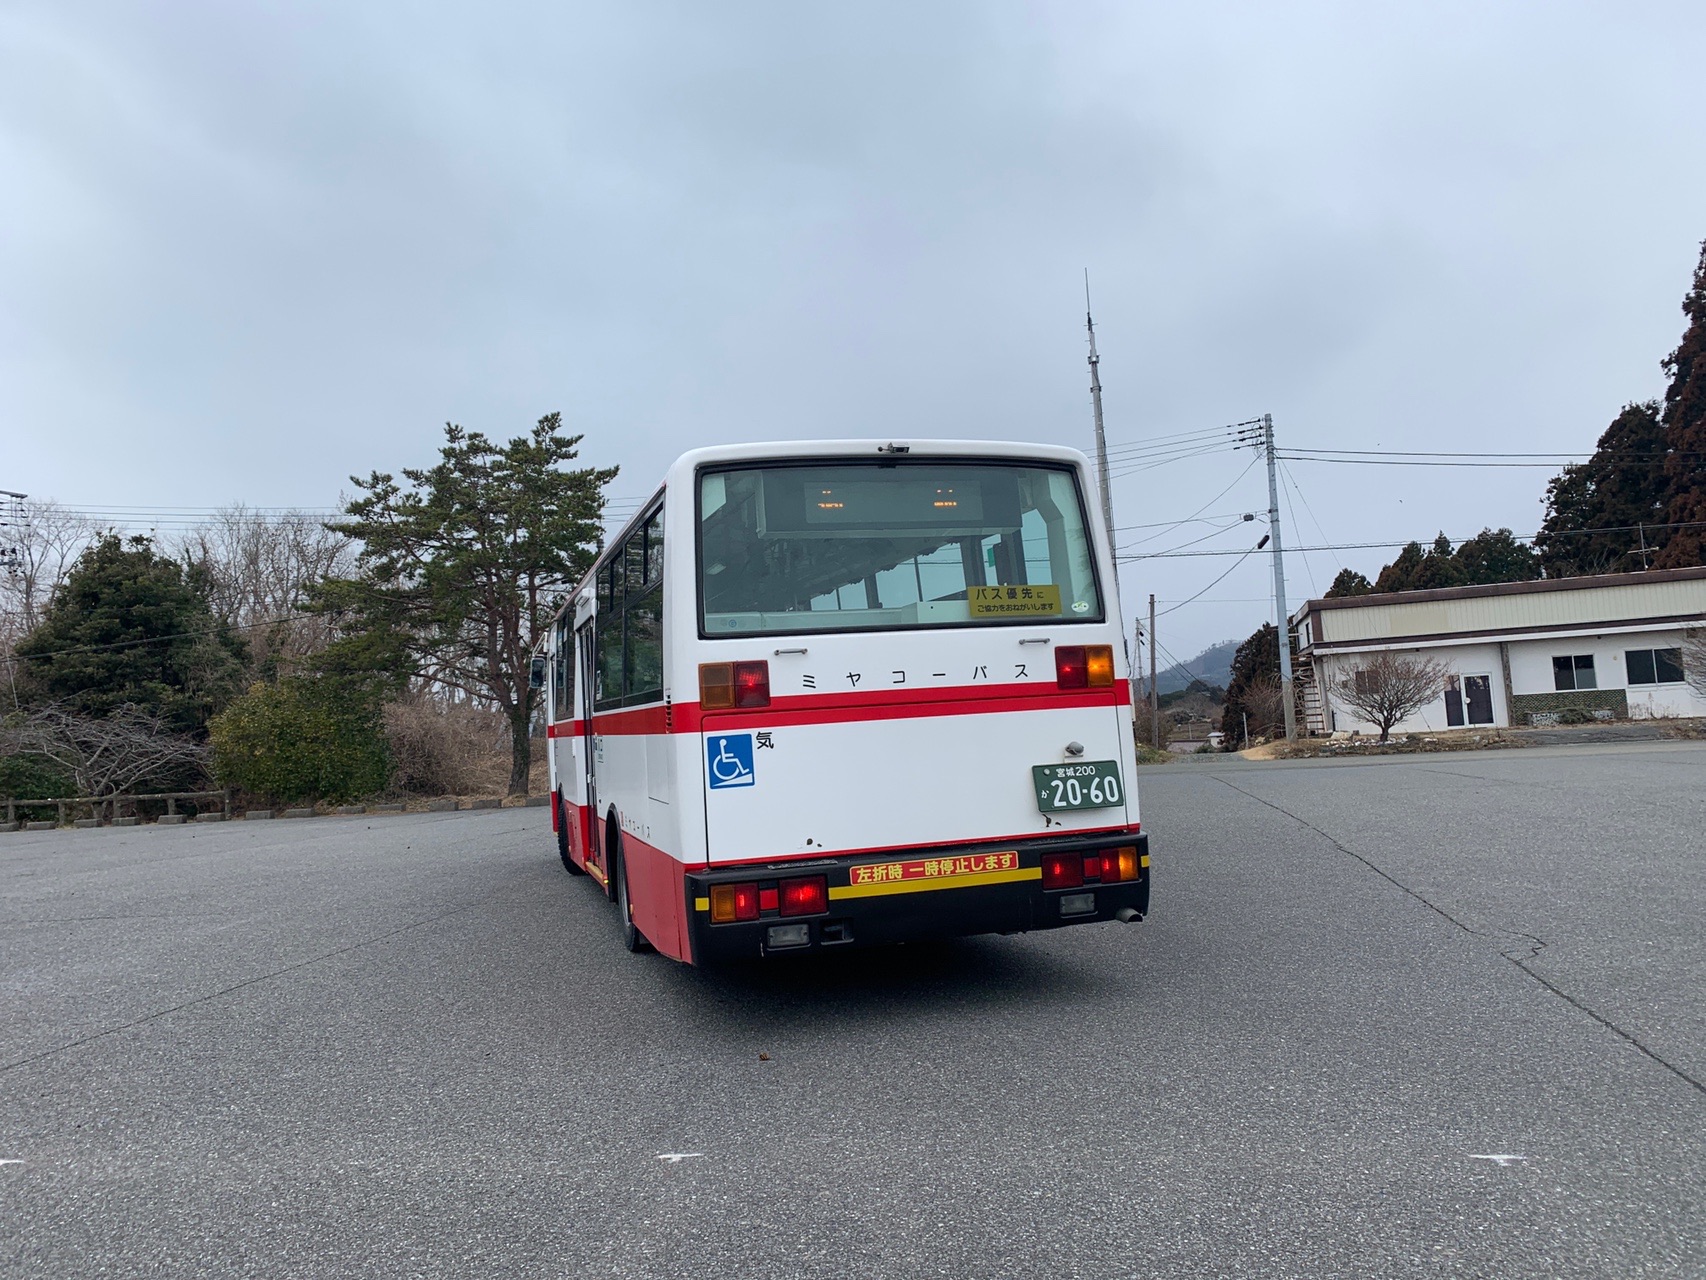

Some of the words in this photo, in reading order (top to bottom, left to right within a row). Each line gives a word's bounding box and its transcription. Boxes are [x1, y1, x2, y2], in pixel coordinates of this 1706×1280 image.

[976, 588, 1044, 600] バス優先に
[977, 603, 1054, 612] ご協力をおねがいします
[803, 664, 1028, 689] ミヤコーバス
[756, 732, 774, 750] 気
[1050, 776, 1119, 806] 20-60
